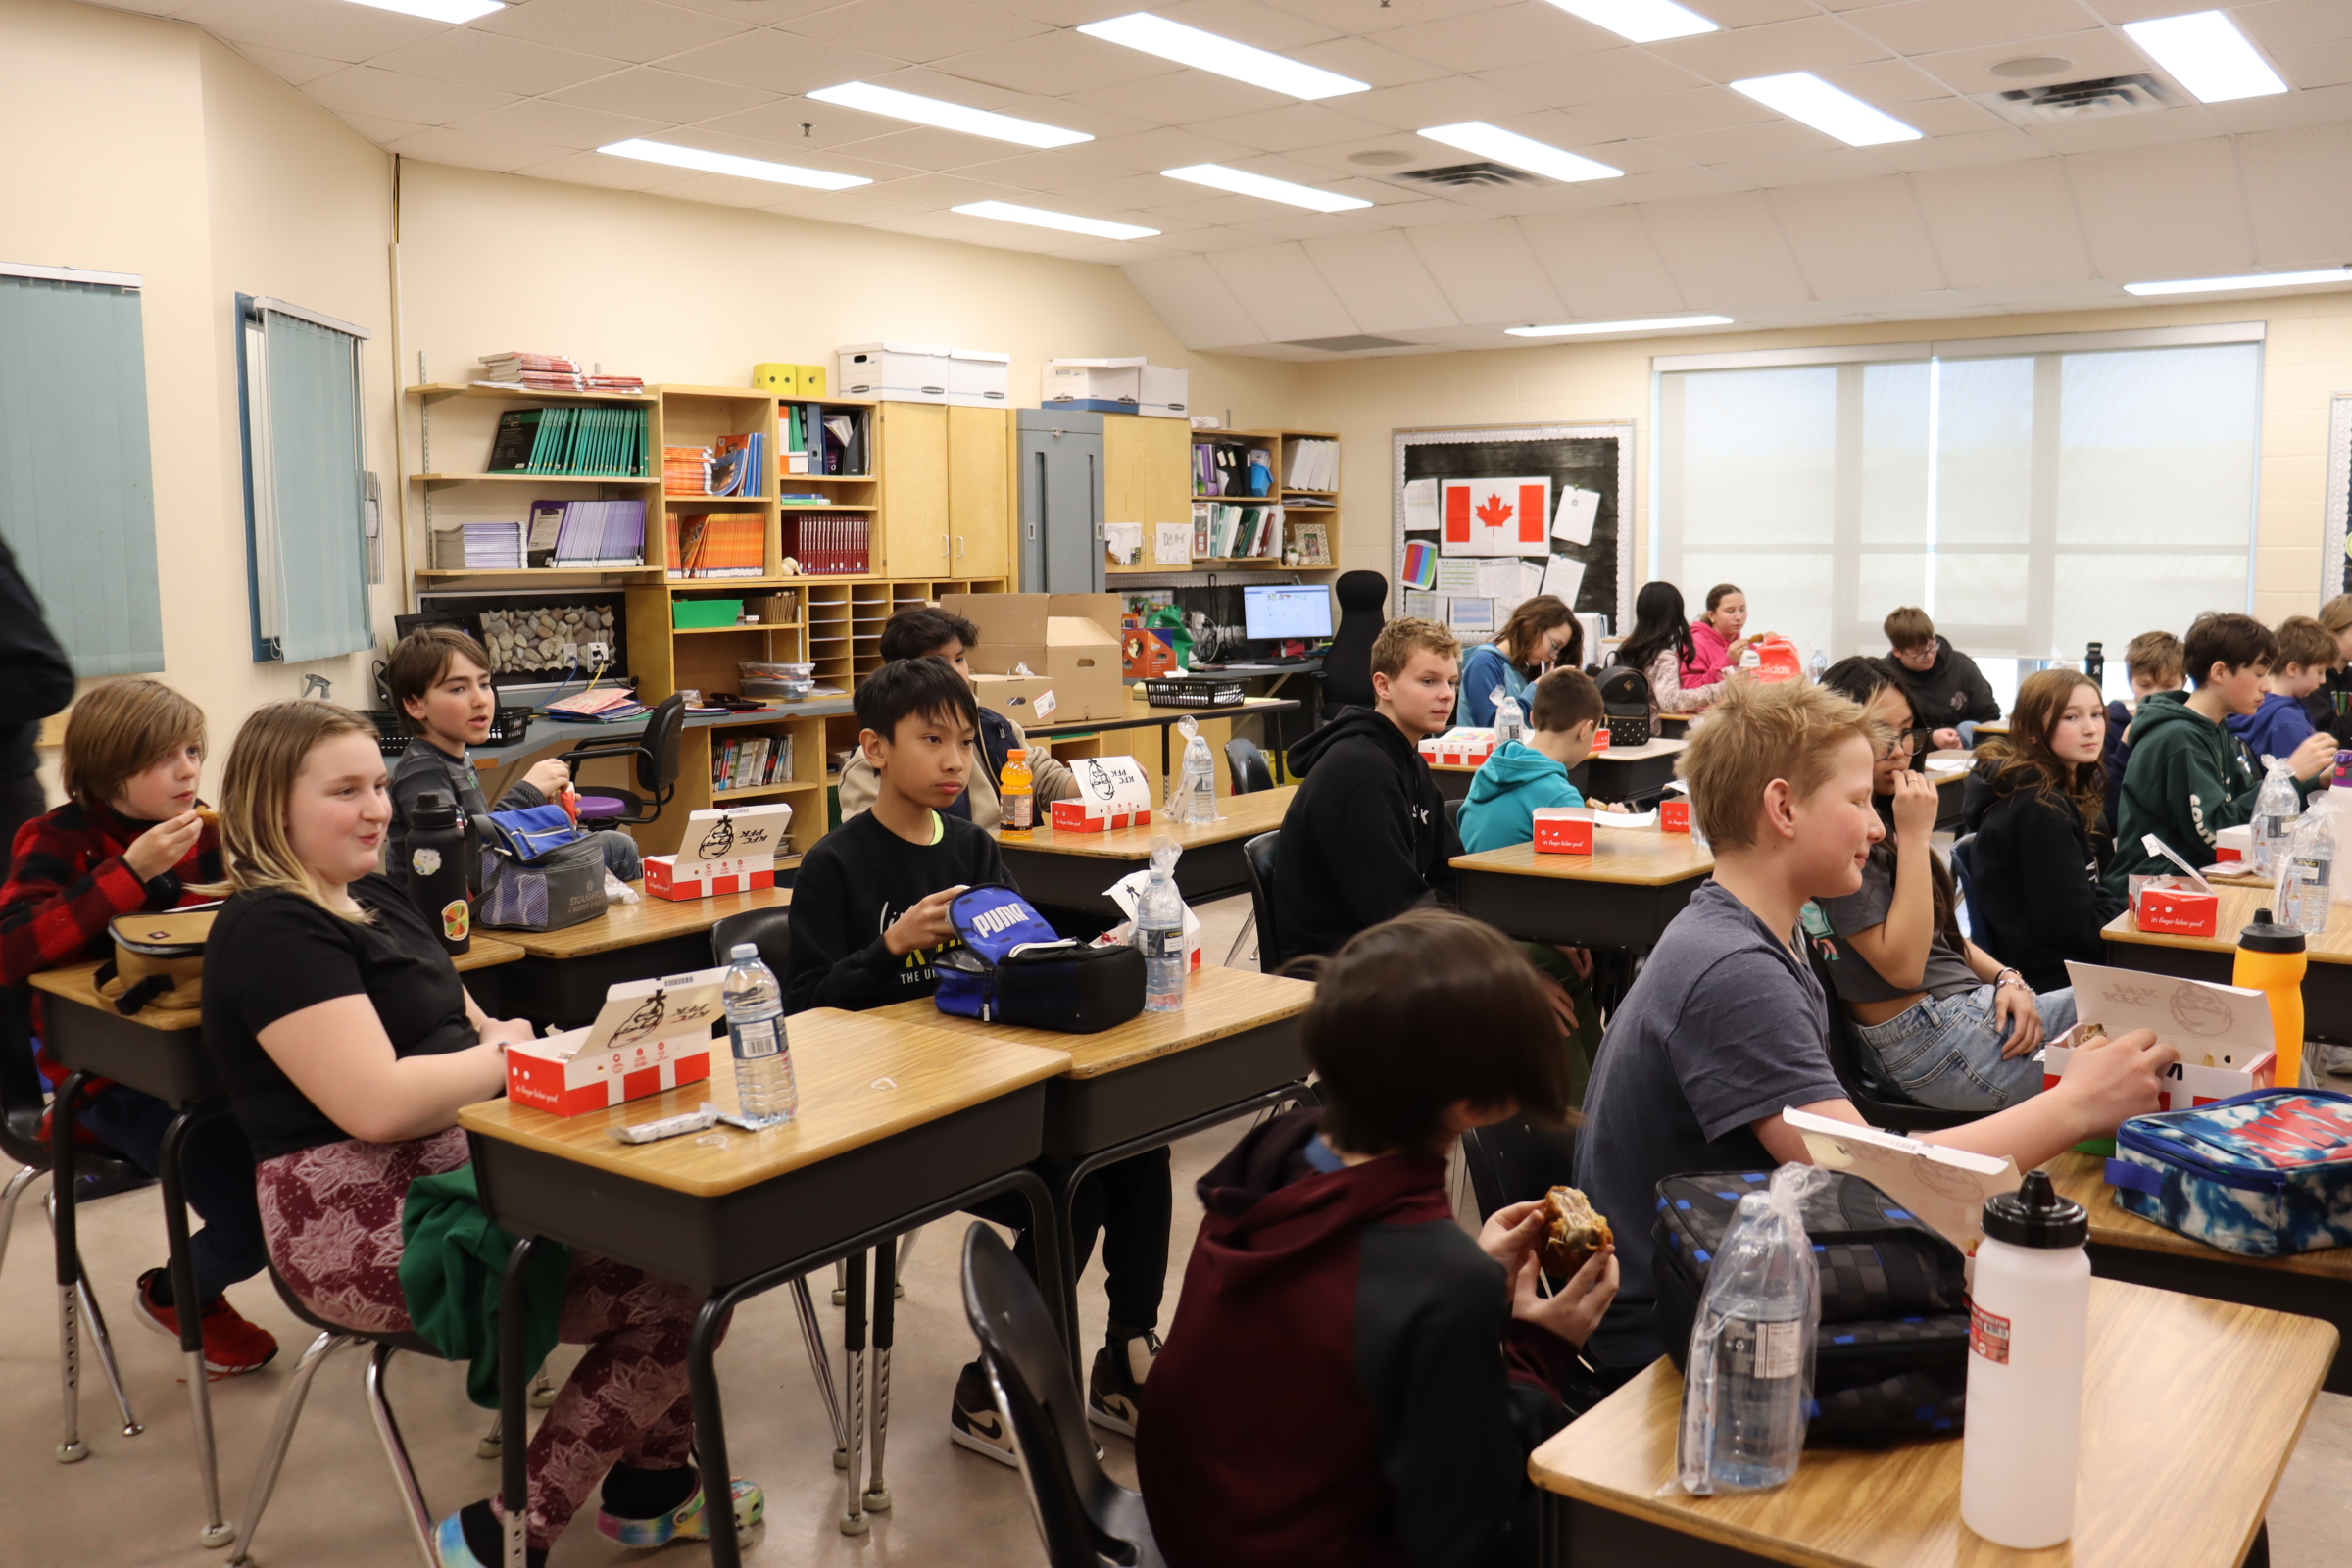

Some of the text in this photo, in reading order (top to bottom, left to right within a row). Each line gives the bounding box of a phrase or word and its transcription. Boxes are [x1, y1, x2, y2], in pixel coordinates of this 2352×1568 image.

[1163, 532, 1186, 546] DARK
[1757, 662, 1790, 675] didas
[737, 828, 765, 839] PFK
[741, 834, 769, 845] KFC
[971, 902, 1030, 939] PUMA
[900, 970, 920, 985] THE
